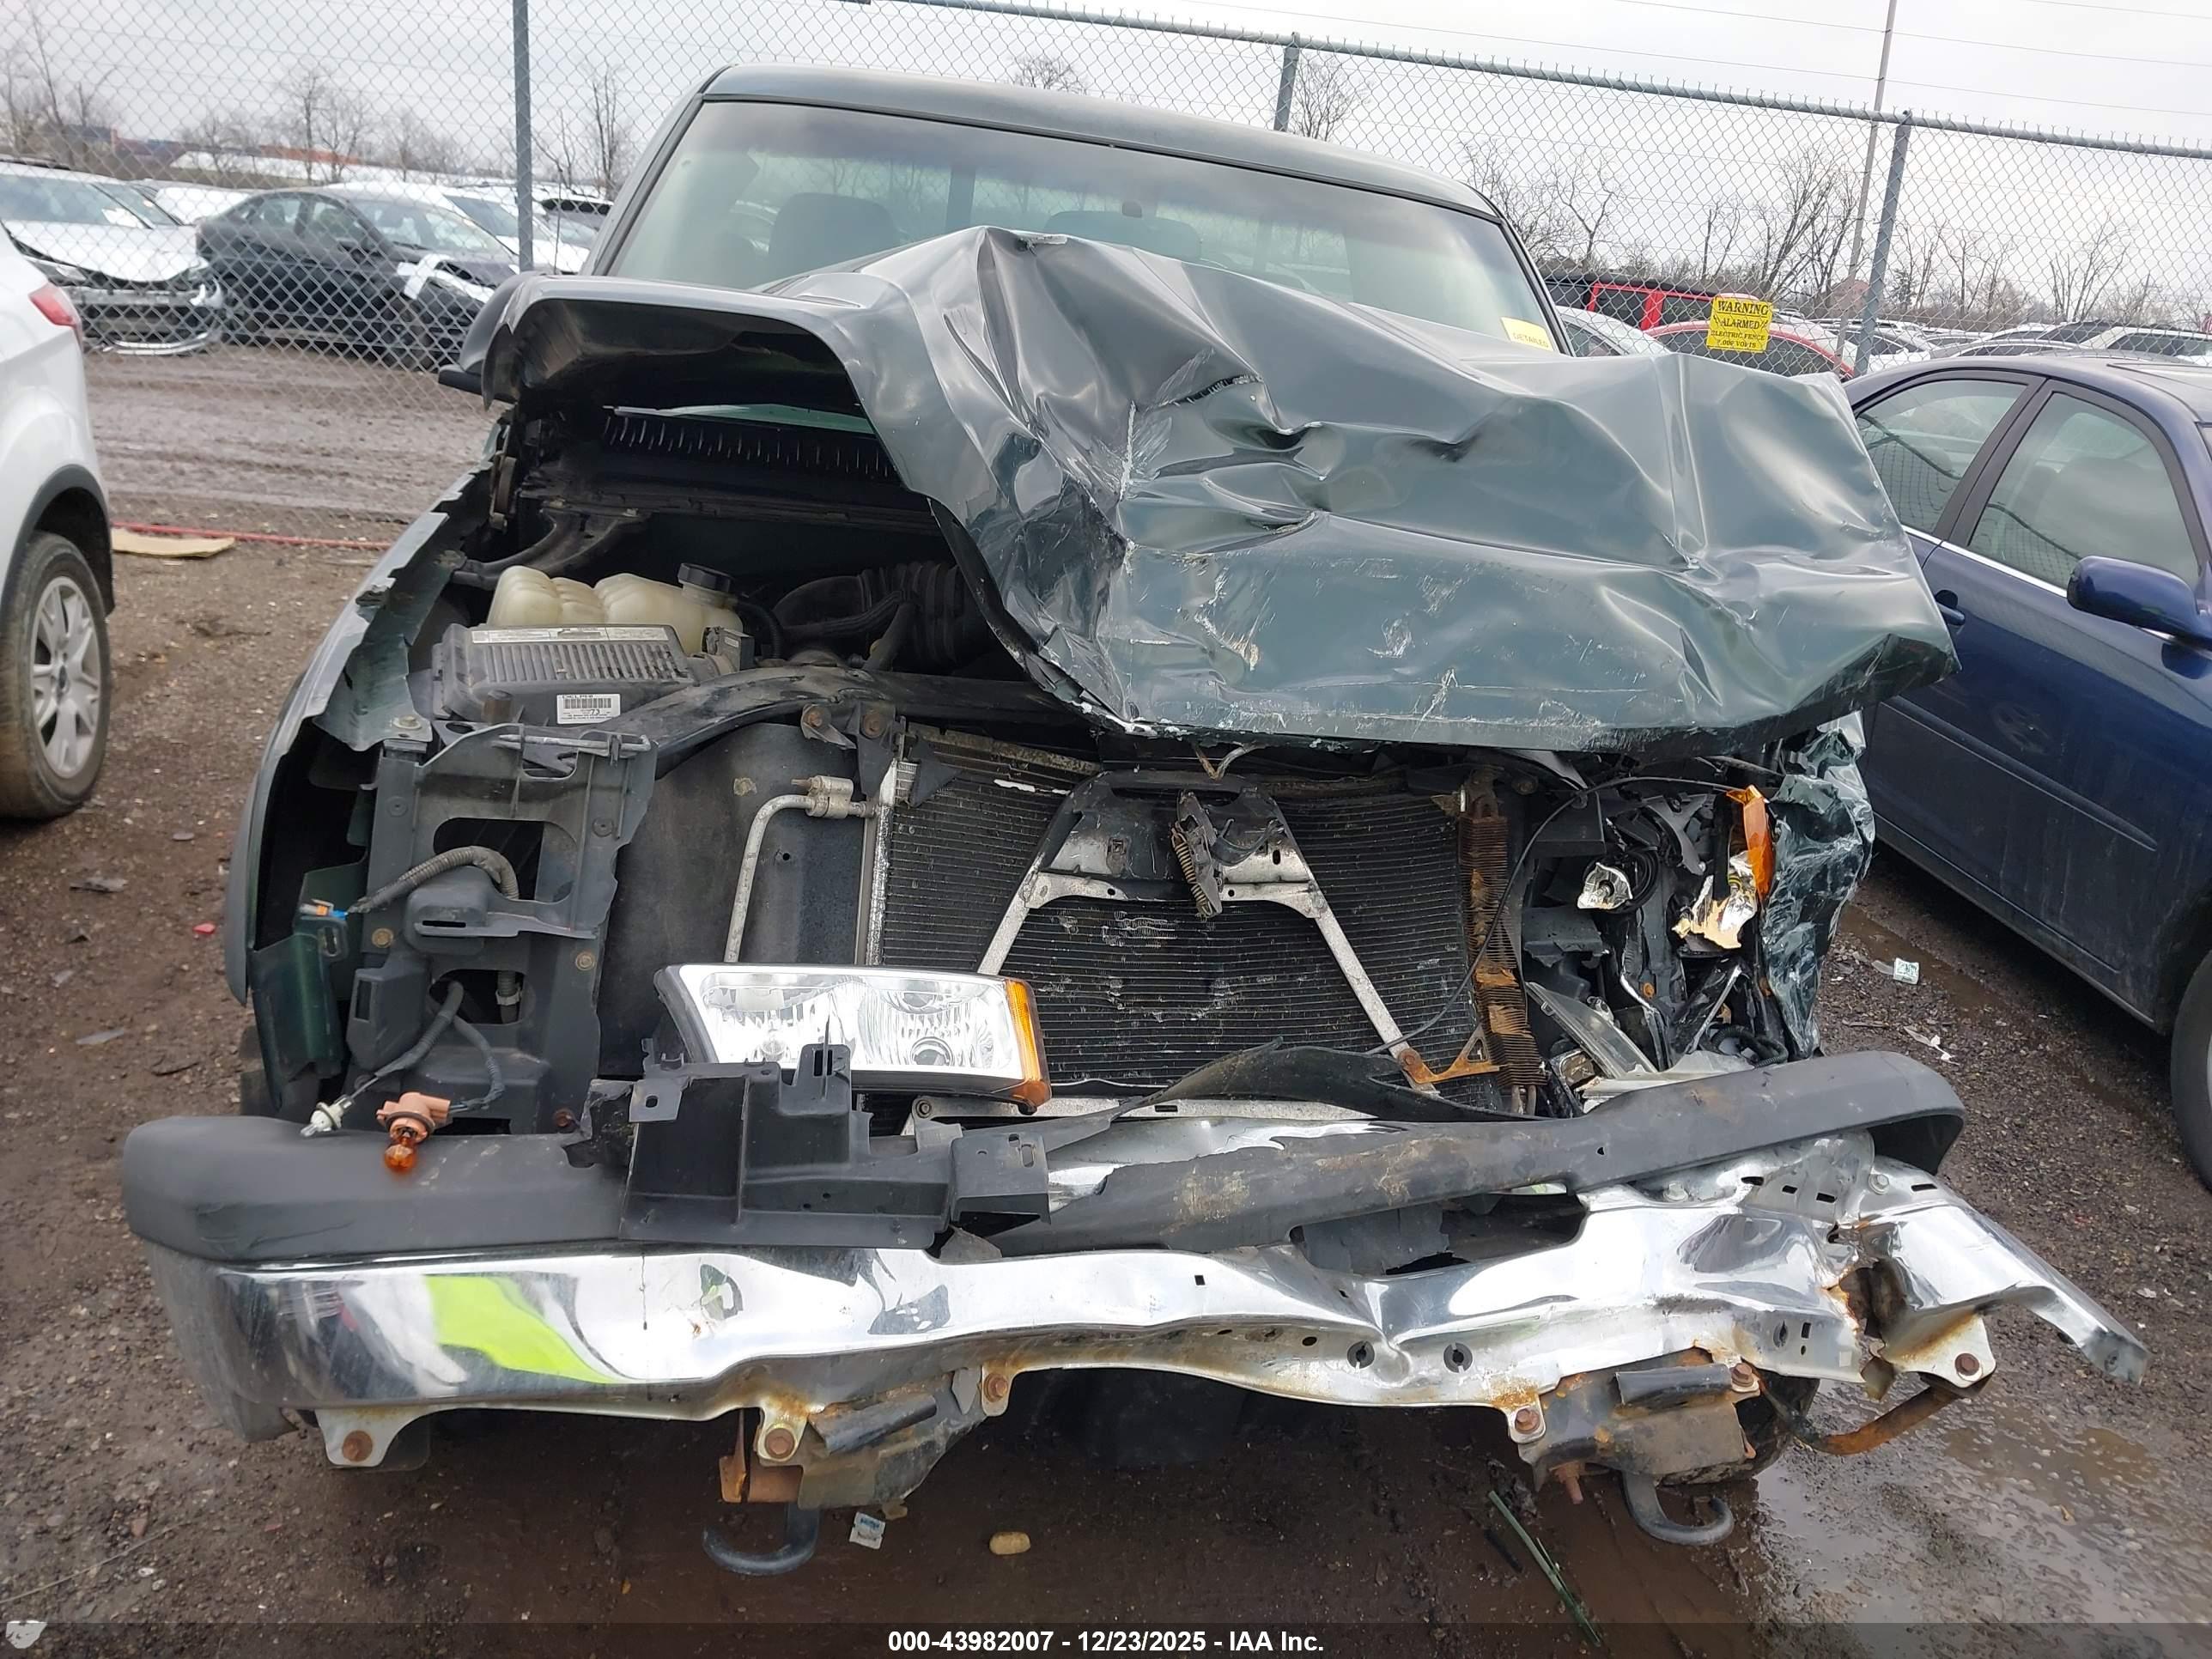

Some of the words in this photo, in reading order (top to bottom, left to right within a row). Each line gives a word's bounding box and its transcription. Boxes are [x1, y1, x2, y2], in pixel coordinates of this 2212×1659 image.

[1718, 301, 1769, 315] WARNING
[1721, 319, 1759, 329] ALARMED
[1711, 330, 1743, 338] ELECTRIC
